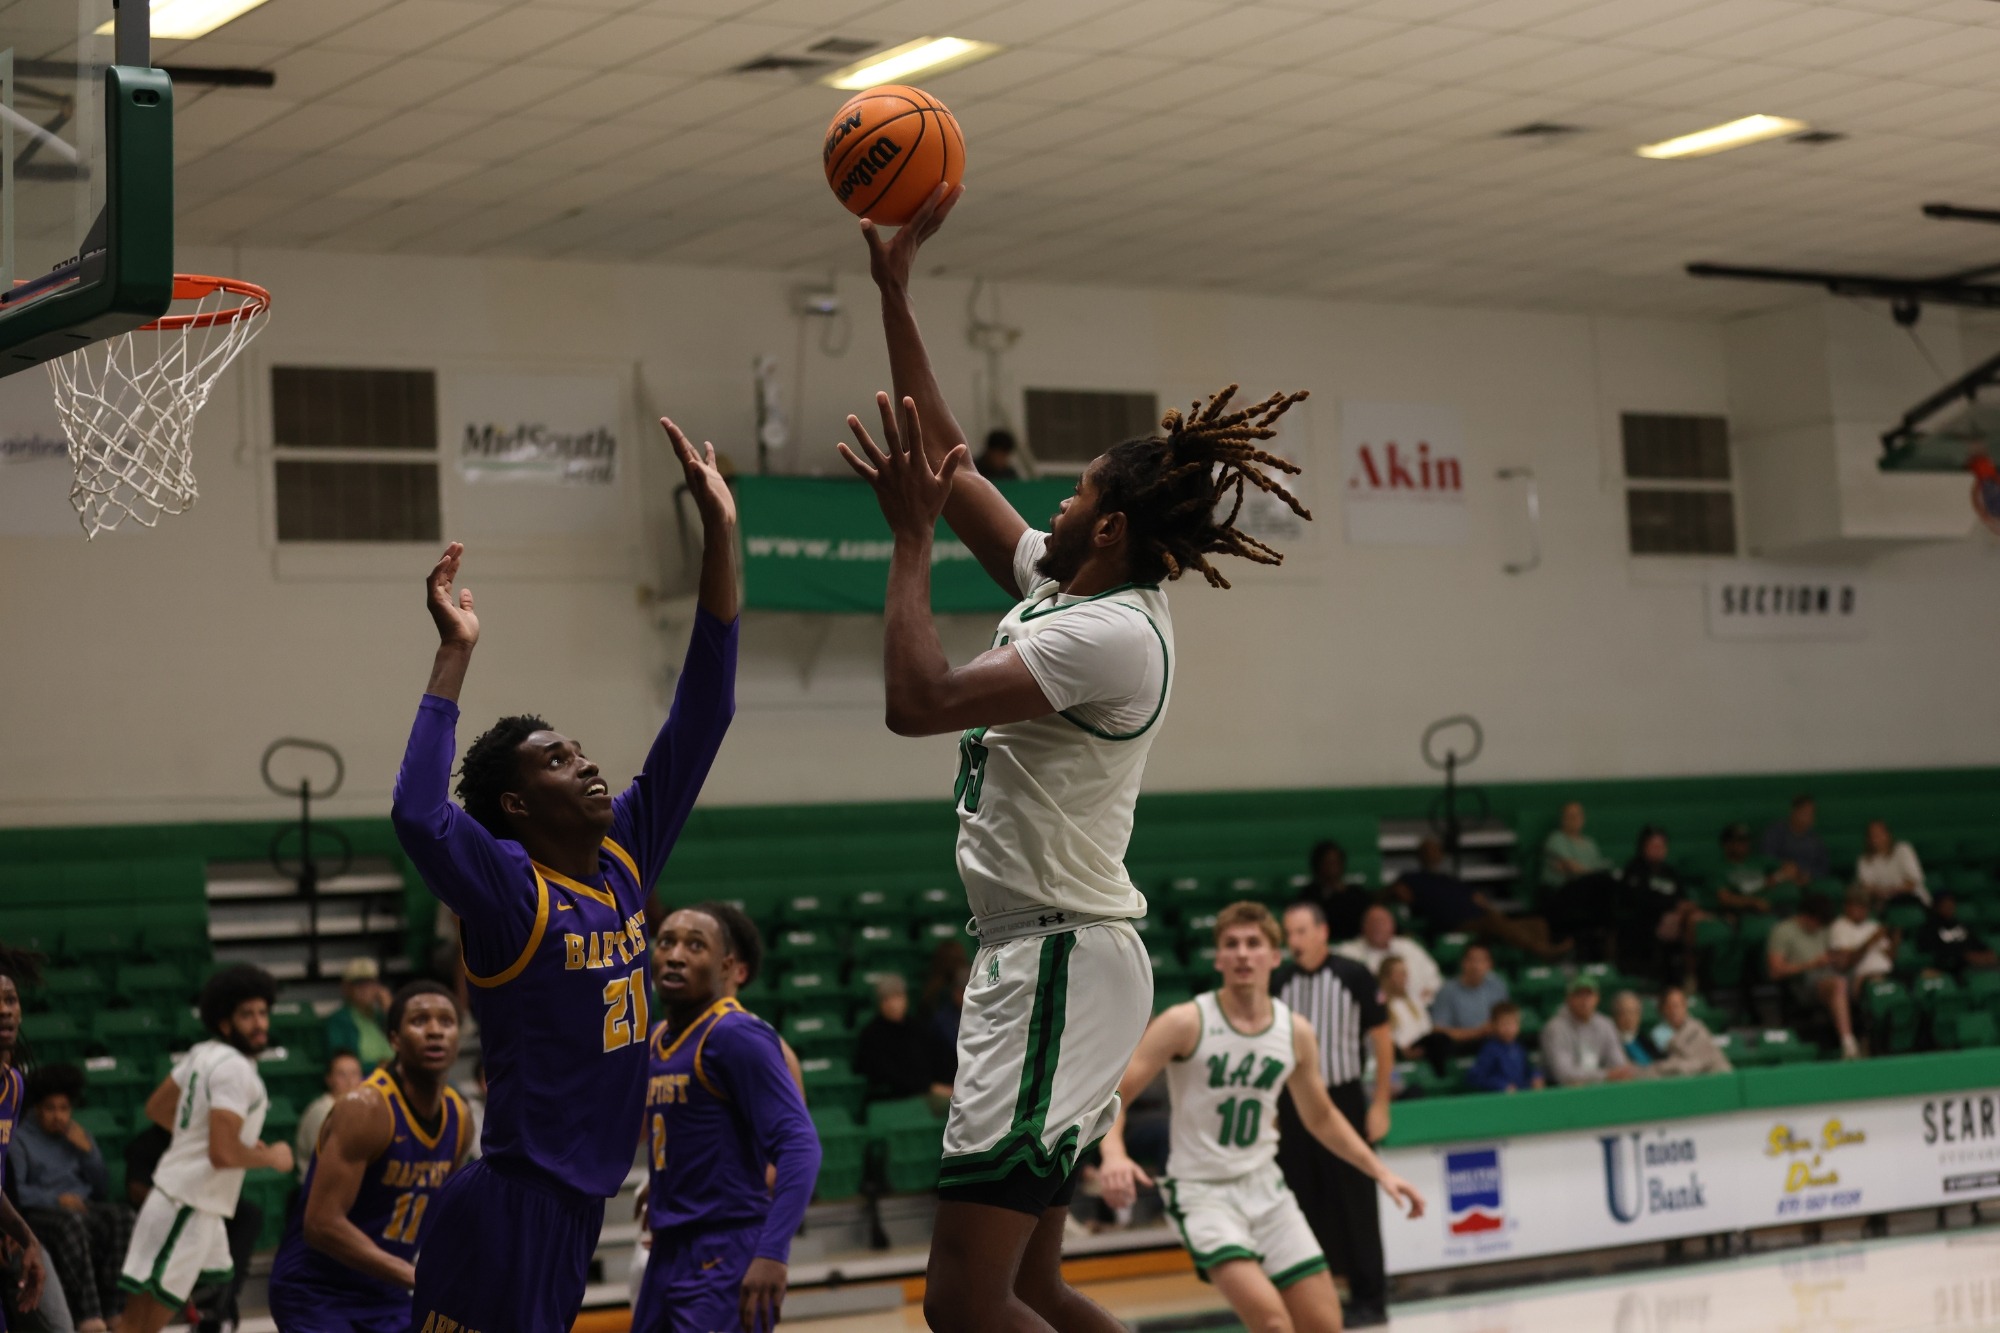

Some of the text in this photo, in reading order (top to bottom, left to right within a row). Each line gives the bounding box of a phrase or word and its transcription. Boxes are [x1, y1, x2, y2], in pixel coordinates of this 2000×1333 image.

[837, 136, 902, 203] Wilson
[1350, 441, 1461, 490] Akin
[1722, 585, 1829, 615] SECTION
[602, 967, 649, 1053] 21
[1216, 1096, 1262, 1149] 10
[1922, 1096, 2000, 1144] SEAR
[1599, 1131, 1696, 1223] Union
[1648, 1172, 1706, 1213] Bank
[382, 1191, 429, 1245] 11
